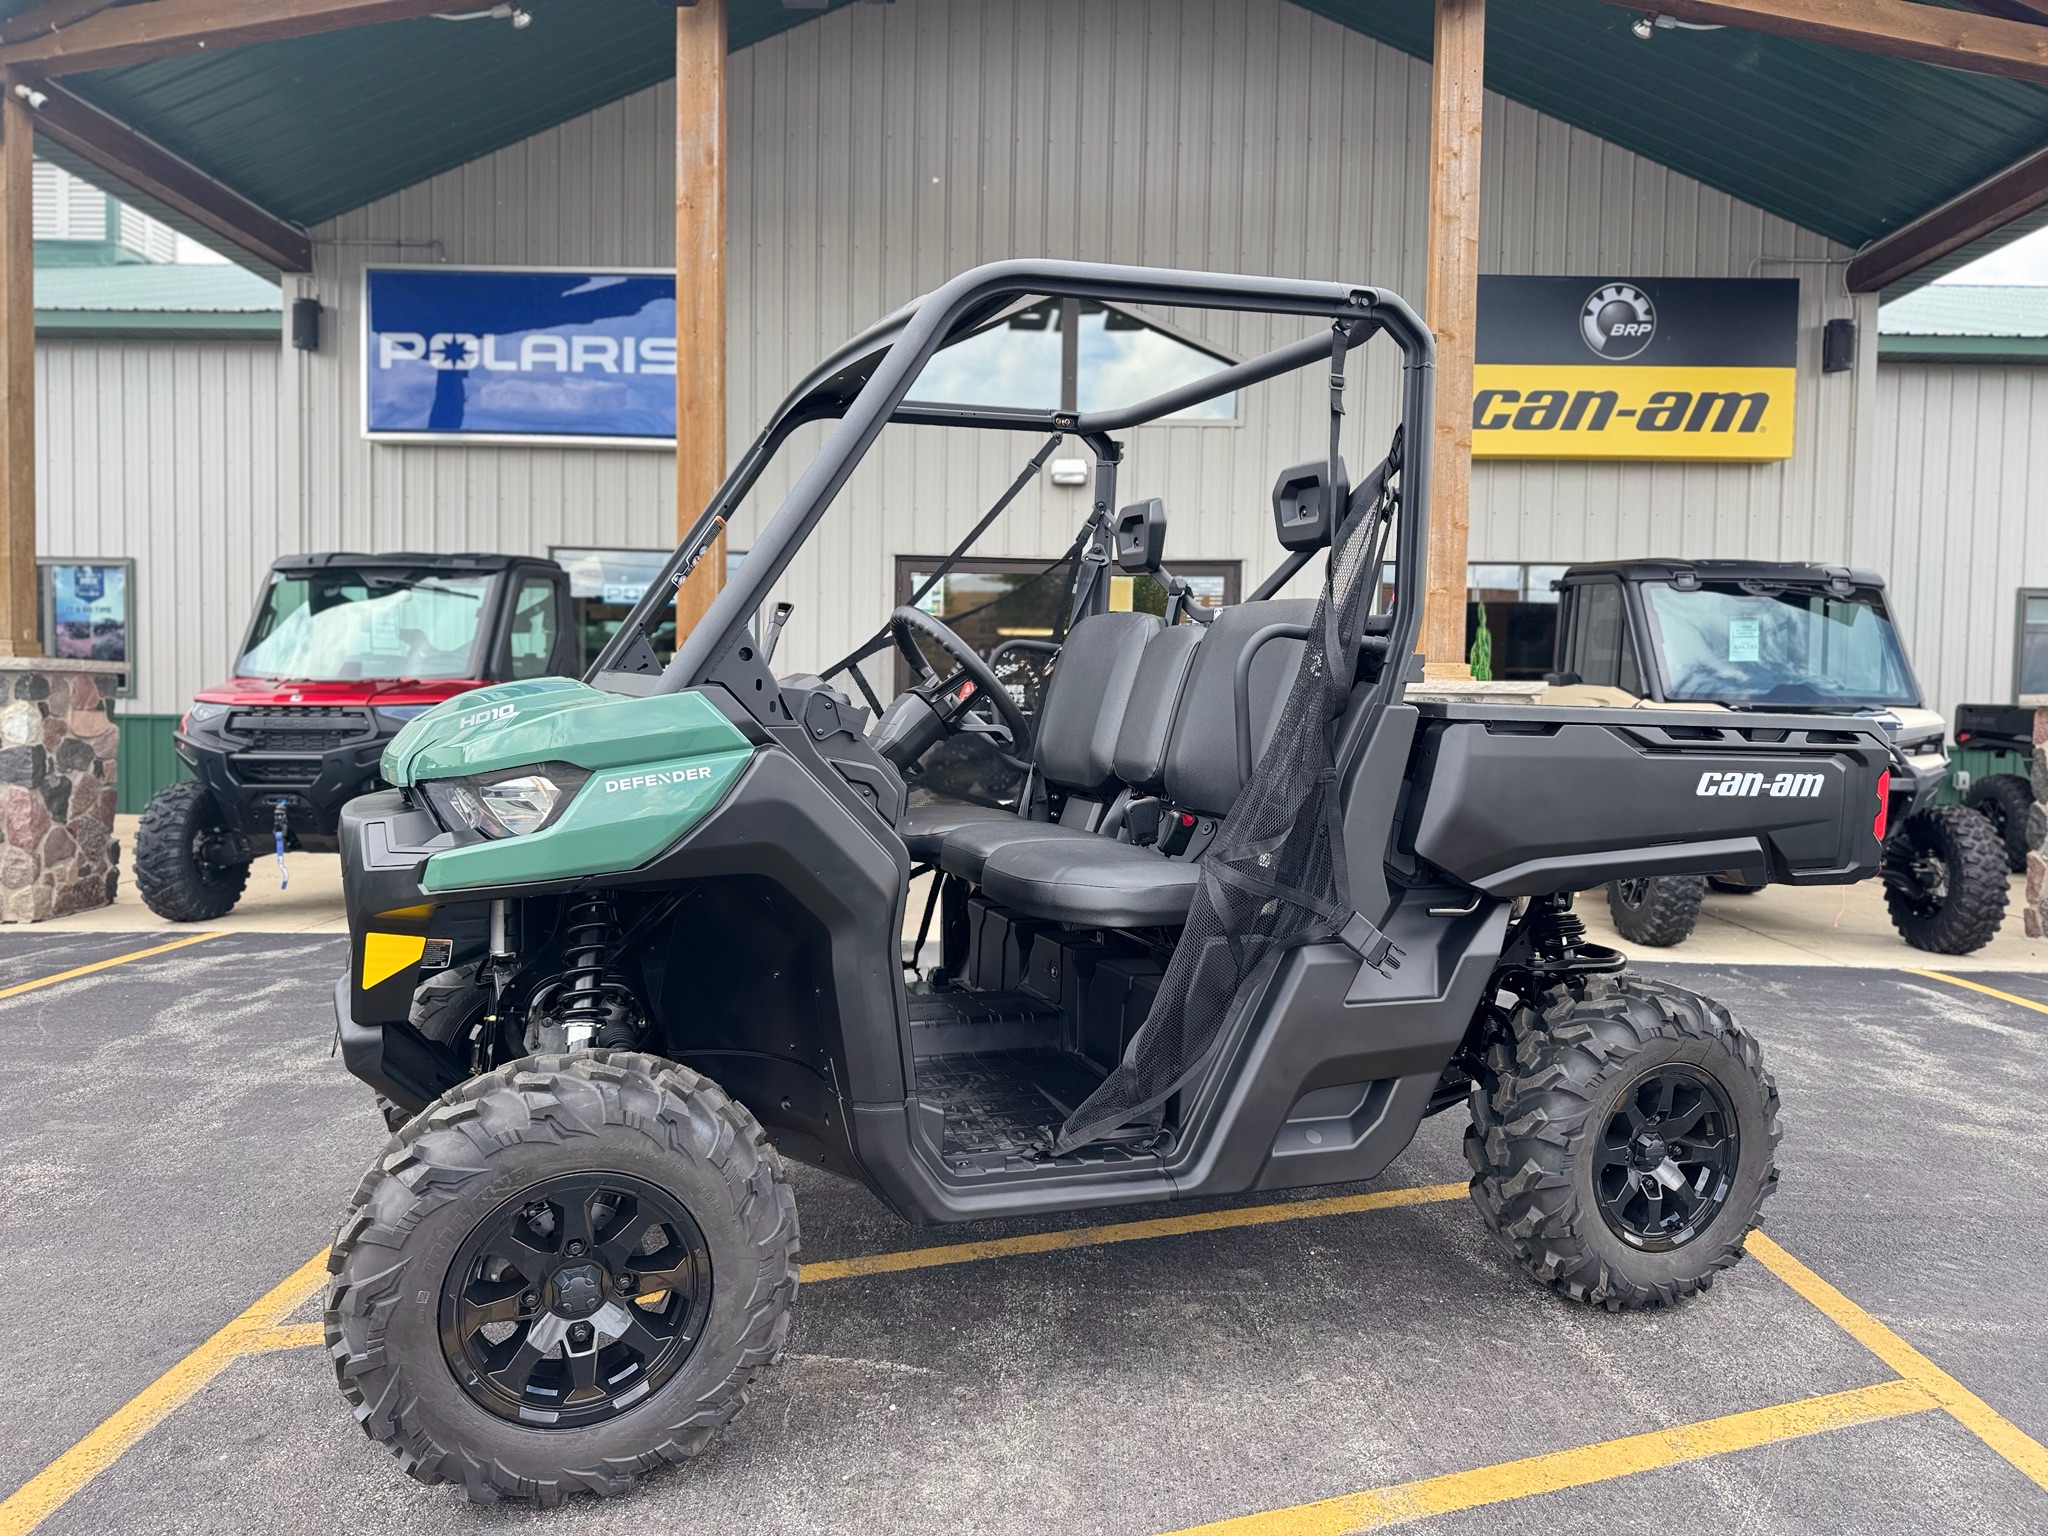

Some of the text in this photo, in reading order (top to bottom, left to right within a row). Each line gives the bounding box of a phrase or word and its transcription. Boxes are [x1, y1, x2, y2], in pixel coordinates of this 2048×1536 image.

[1610, 323, 1652, 337] BRP
[379, 332, 677, 375] POLARIS
[1473, 389, 1770, 433] can-am
[459, 703, 515, 729] HD10
[605, 766, 712, 793] DEFENDER
[1695, 772, 1825, 797] can-am
